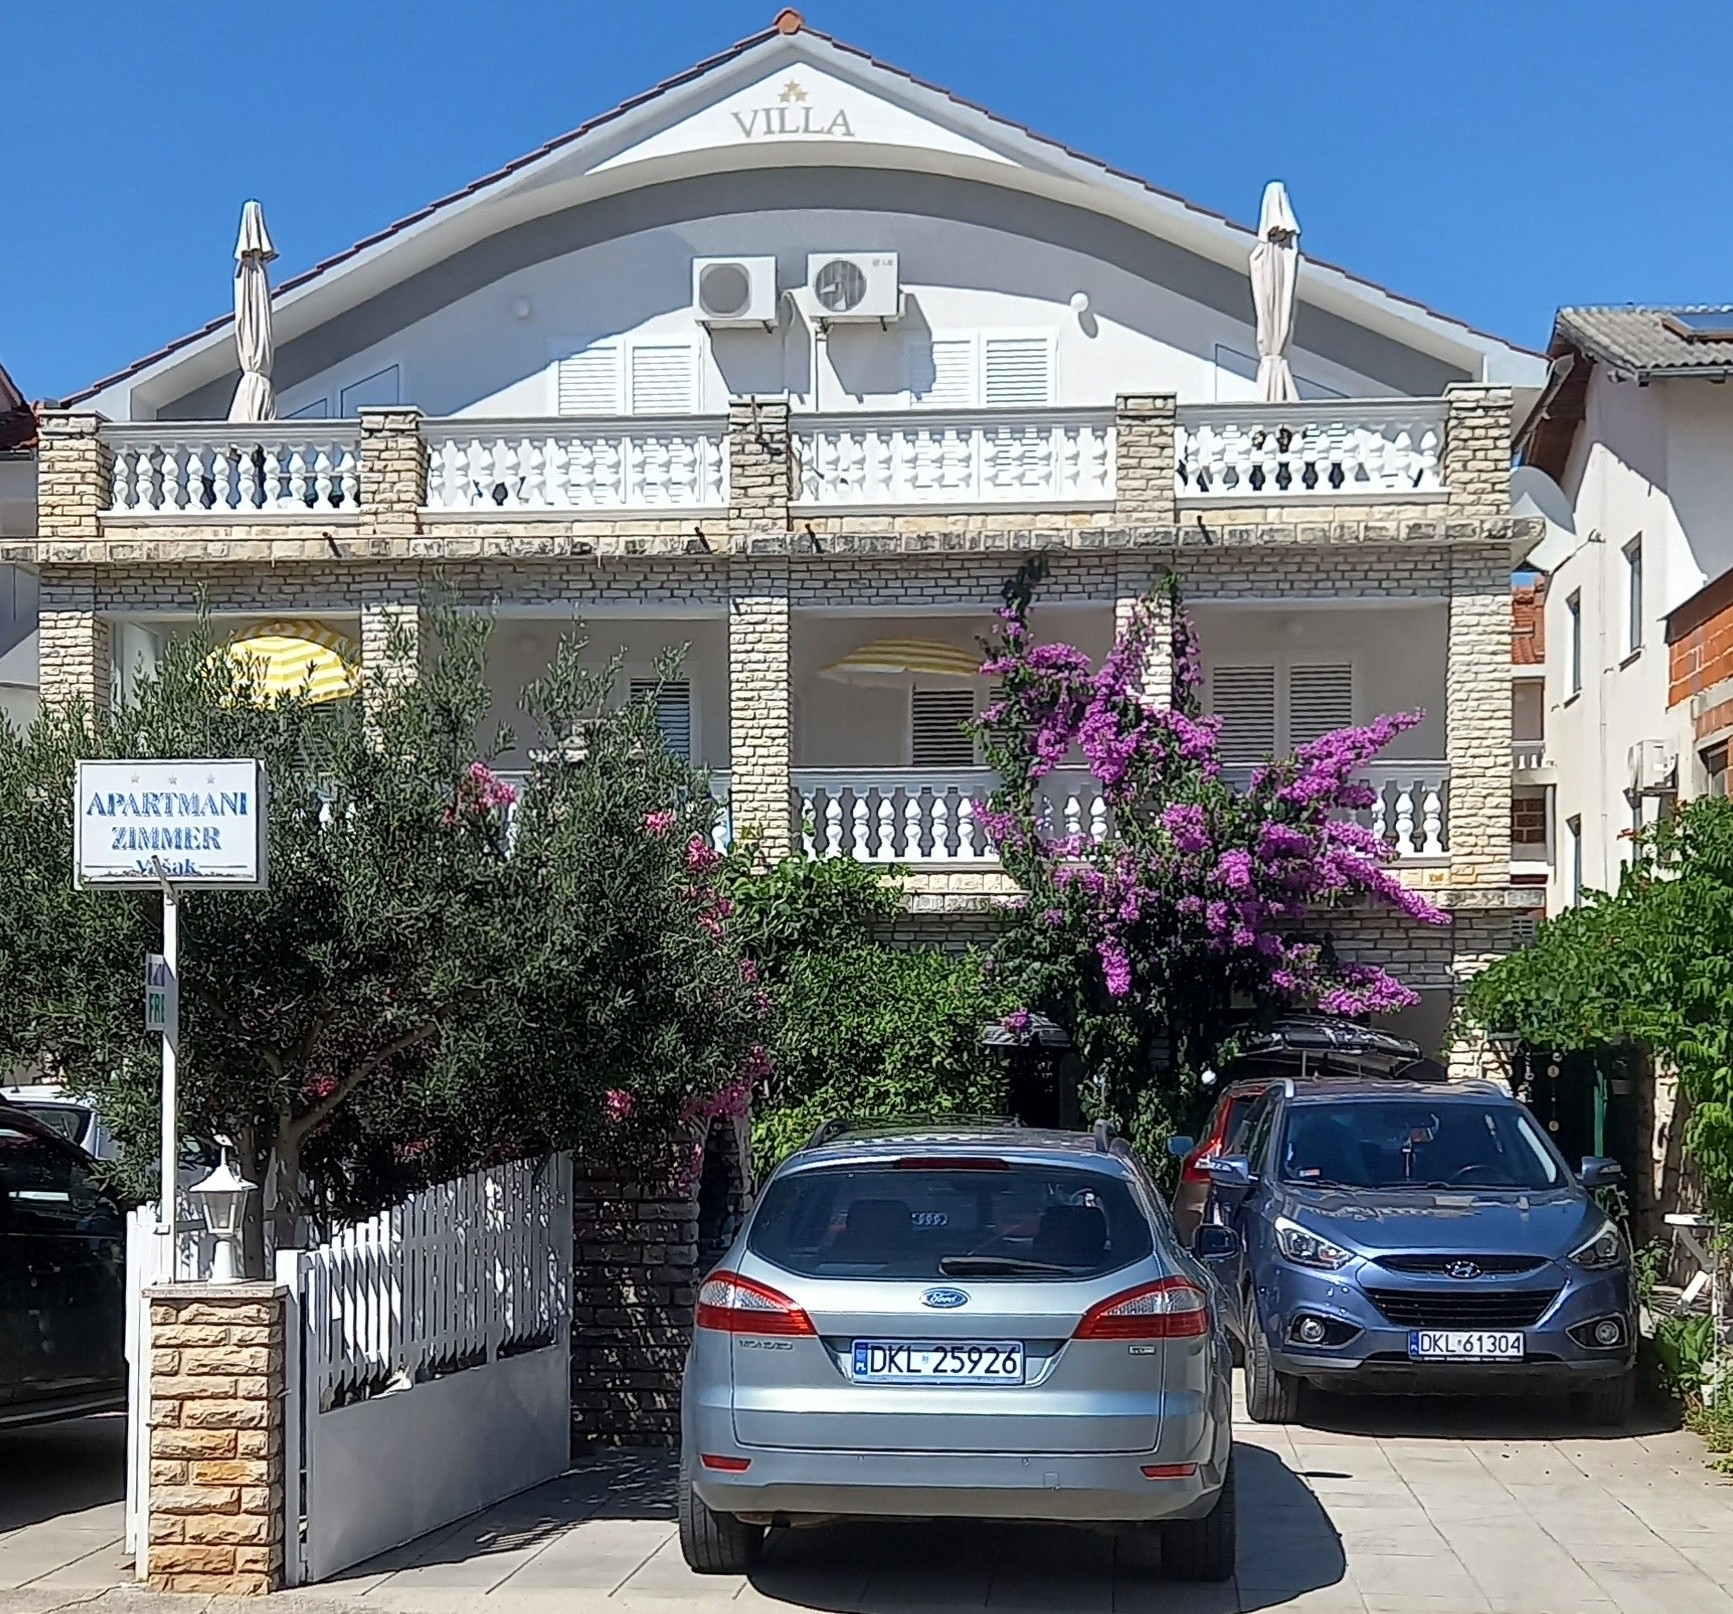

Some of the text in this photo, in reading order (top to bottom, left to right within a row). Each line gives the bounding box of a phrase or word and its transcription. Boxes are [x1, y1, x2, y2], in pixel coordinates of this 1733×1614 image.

[730, 106, 855, 138] VILLA
[86, 792, 248, 817] APARTMANI
[111, 826, 222, 851] ZIMMER
[1420, 1333, 1521, 1354] DKL 61304
[870, 1345, 1018, 1374] DKL 25926
